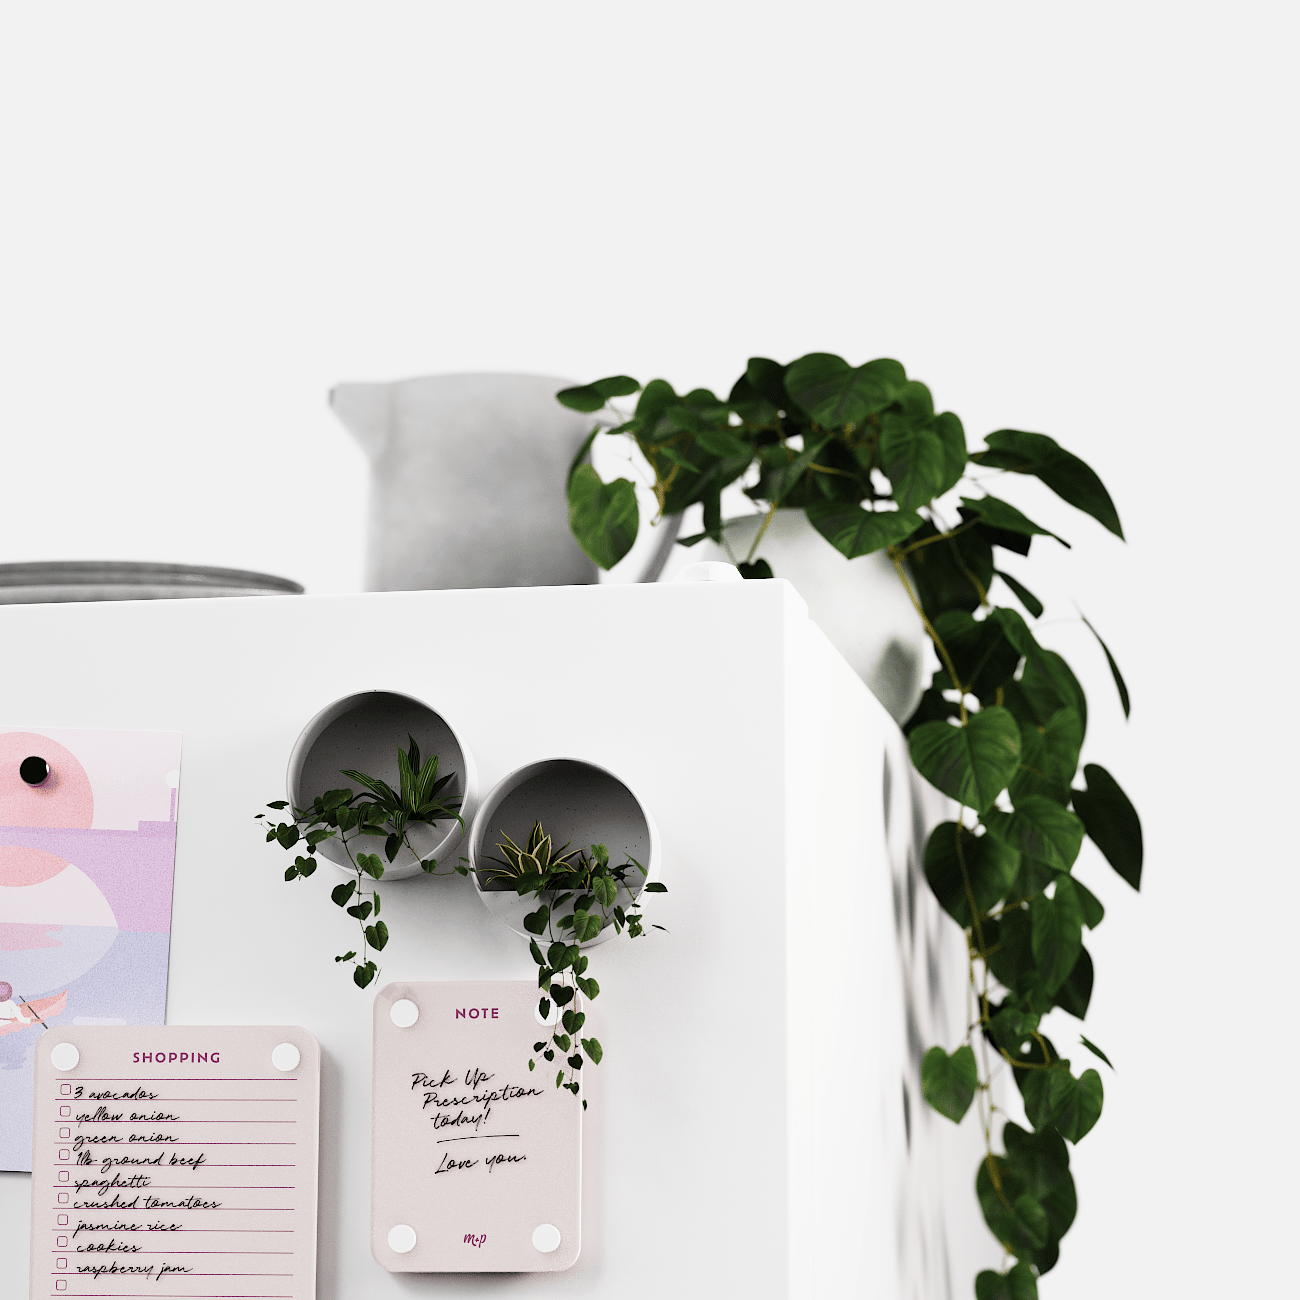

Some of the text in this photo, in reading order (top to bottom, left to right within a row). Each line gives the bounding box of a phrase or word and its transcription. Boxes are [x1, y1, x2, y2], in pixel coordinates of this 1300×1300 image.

[455, 1007, 499, 1020] NOTE
[132, 1051, 220, 1064] SHOPPING
[411, 1067, 495, 1090] Pick Up
[74, 1086, 158, 1100] 3 avocados
[422, 1084, 545, 1110] Prescription
[75, 1106, 180, 1128] yellow onion
[430, 1107, 491, 1132] today!
[72, 1132, 180, 1152] green onion
[100, 1152, 164, 1174] ground
[168, 1152, 207, 1170] beef
[434, 1152, 479, 1175] Love
[73, 1173, 152, 1196] spaghetti
[73, 1195, 223, 1210] crushed tomatoes
[72, 1220, 183, 1238] jasmine rice
[76, 1238, 143, 1254] cookies
[76, 1262, 194, 1280] raspberry jam
